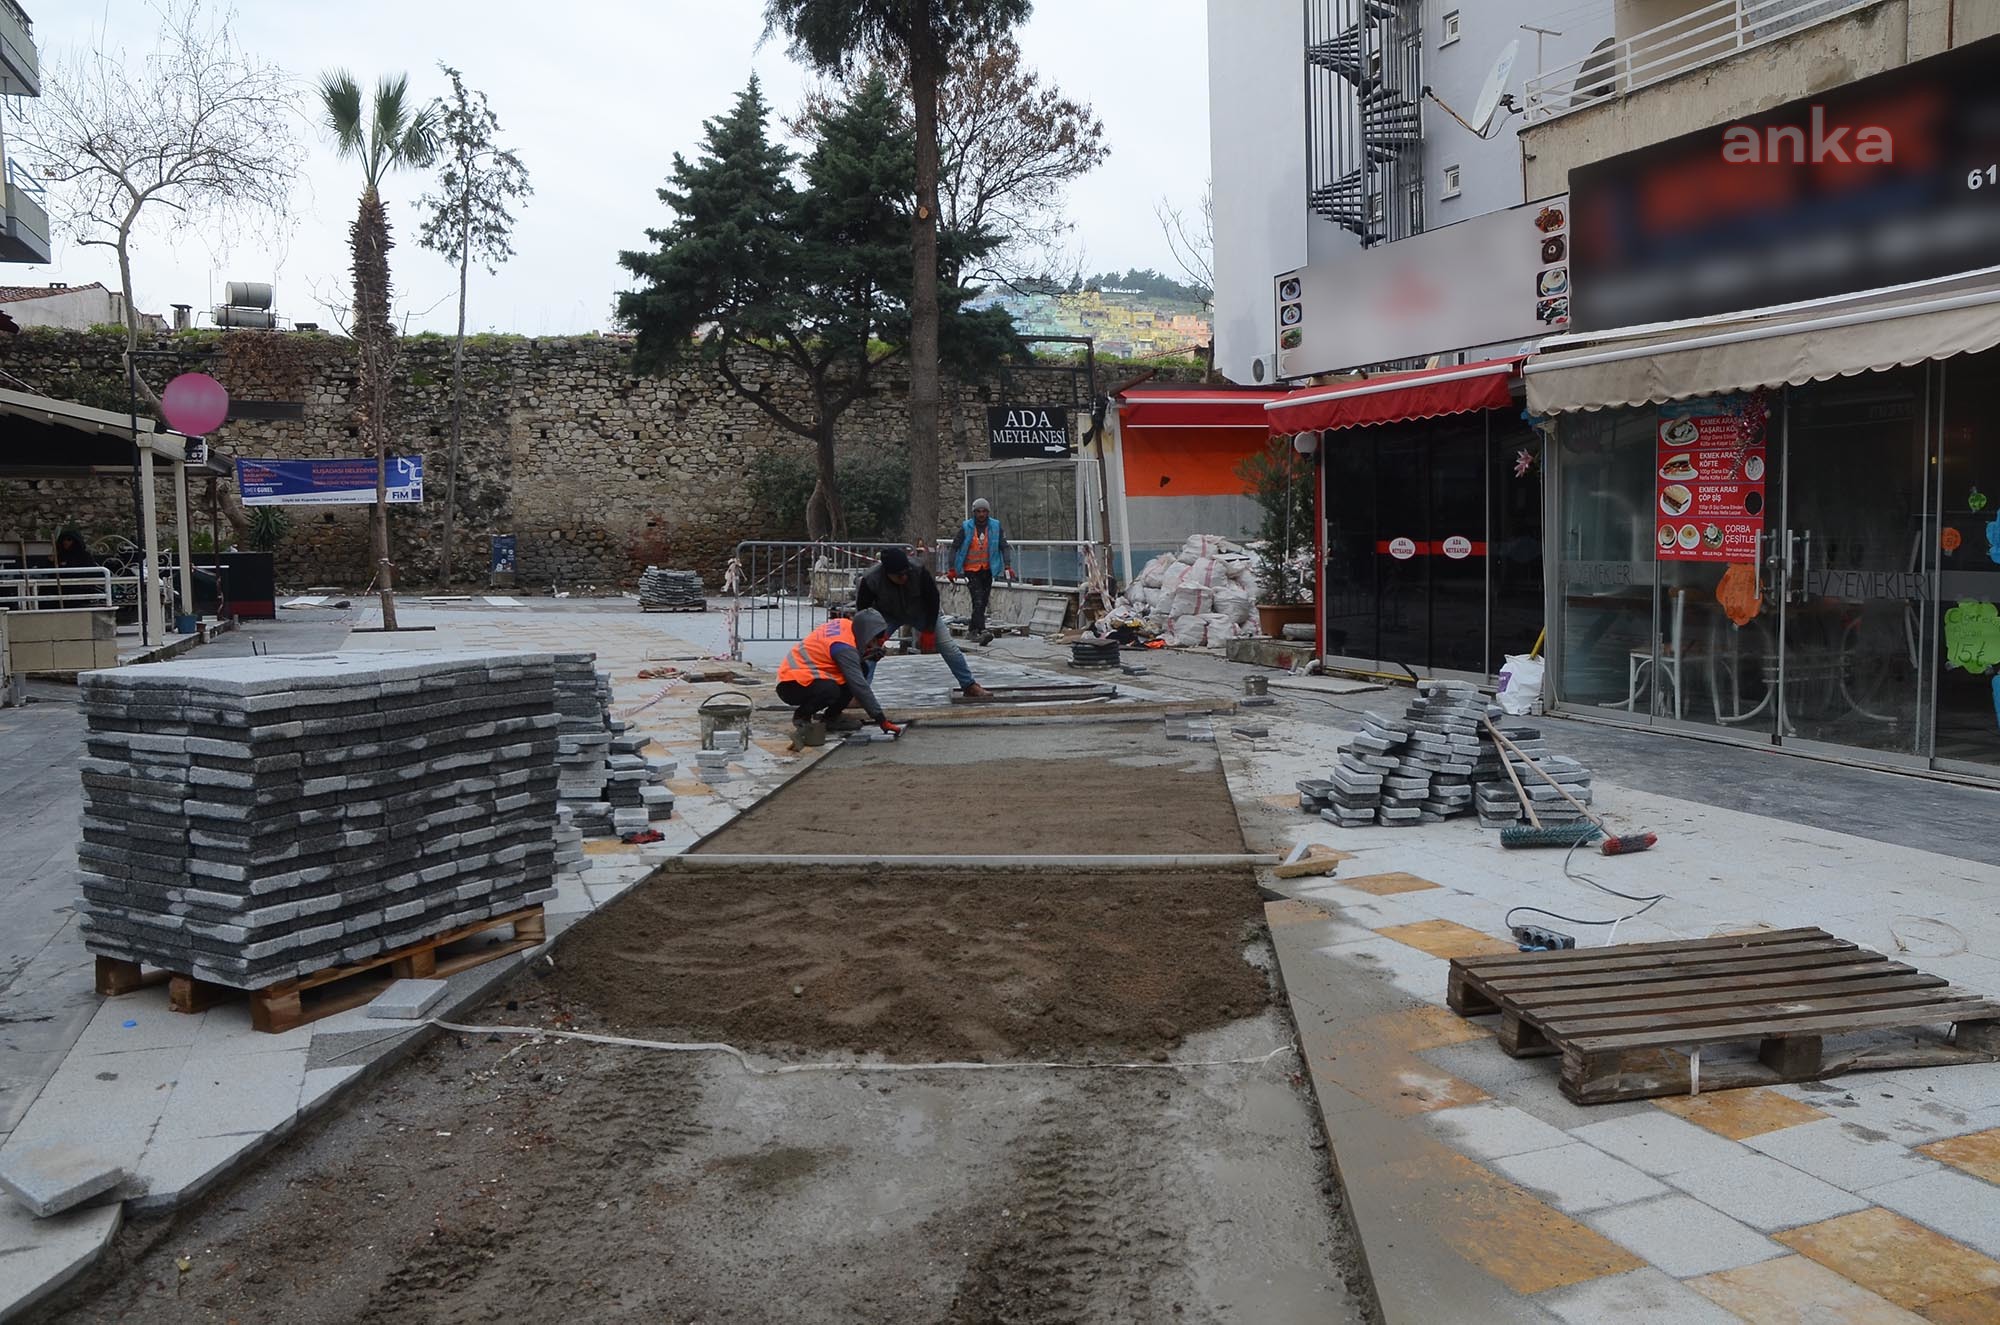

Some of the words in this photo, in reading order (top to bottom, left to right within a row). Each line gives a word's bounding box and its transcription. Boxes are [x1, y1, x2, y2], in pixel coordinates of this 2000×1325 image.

[1967, 164, 1997, 190] 61
[1004, 410, 1052, 428] ADA
[993, 428, 1067, 444] MEYHANESİ
[1700, 426, 1725, 434] KAŞARLI
[1698, 493, 1711, 502] ÇÖP
[1712, 493, 1722, 502] ŞİŞ
[1725, 524, 1751, 534] ÇORBA
[1725, 533, 1757, 545] ÇEŞİTLE
